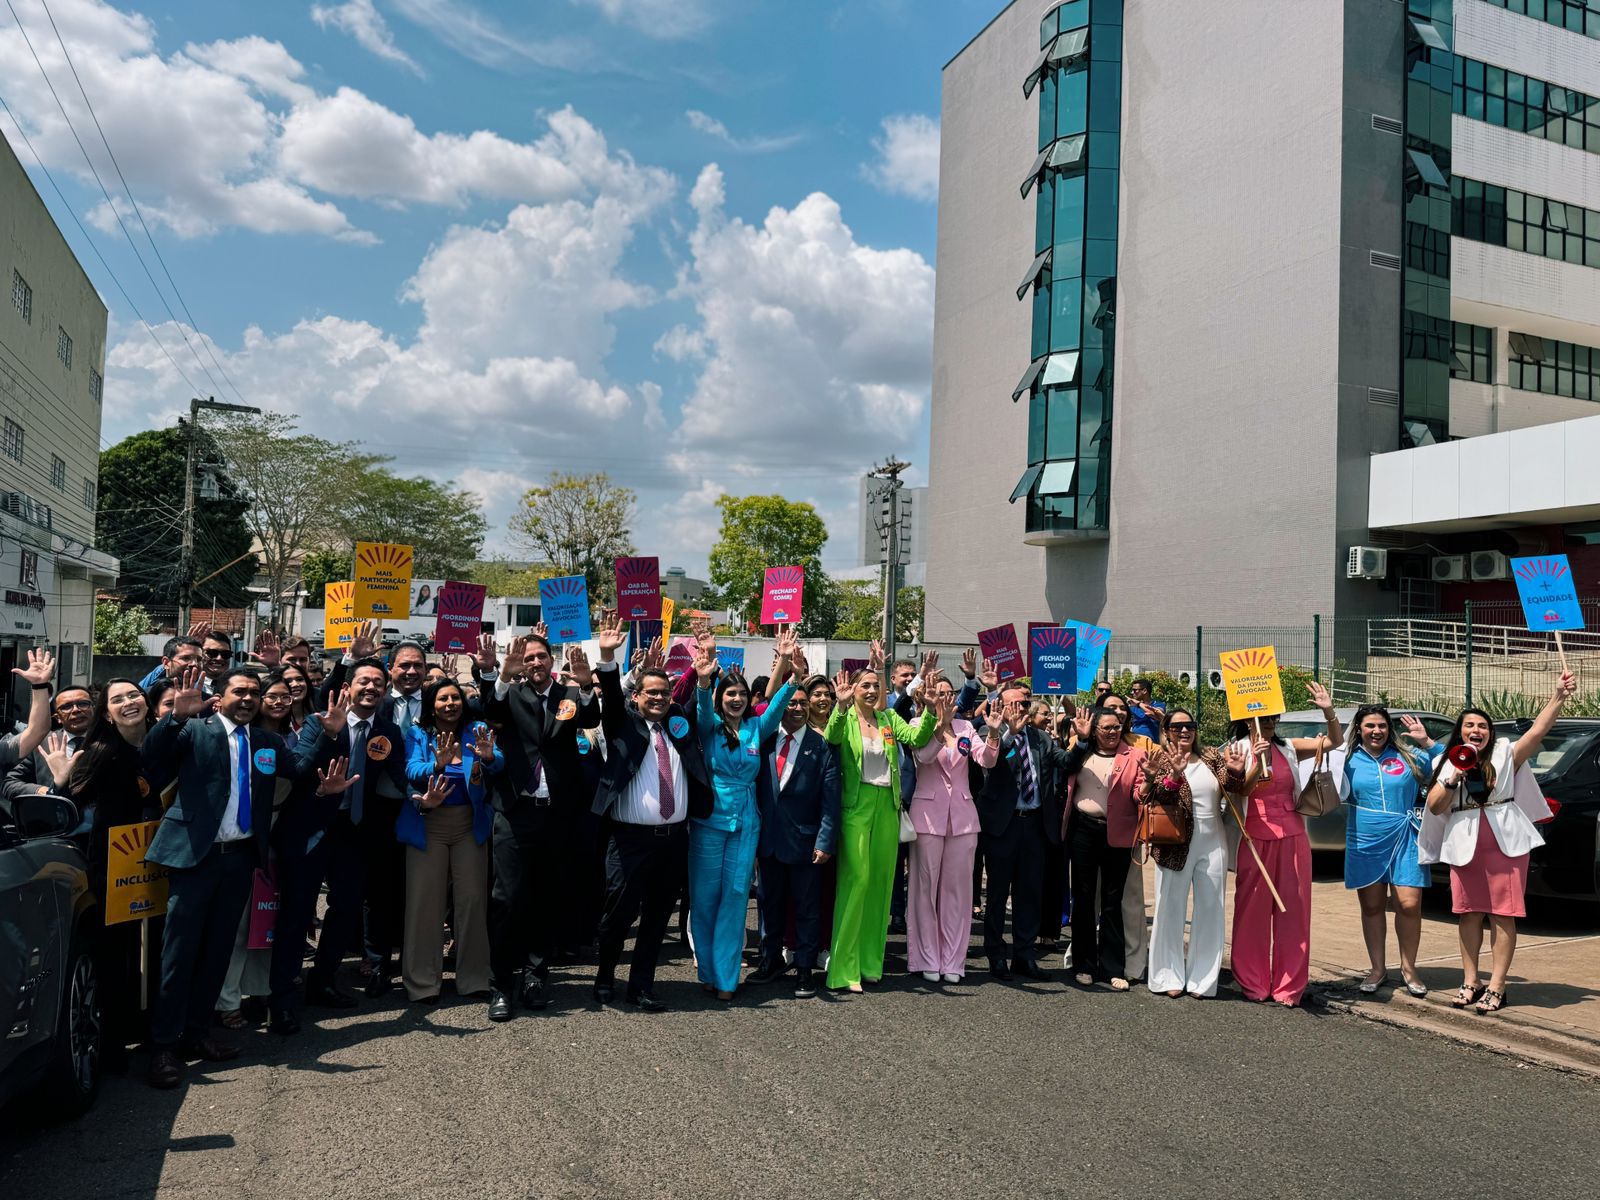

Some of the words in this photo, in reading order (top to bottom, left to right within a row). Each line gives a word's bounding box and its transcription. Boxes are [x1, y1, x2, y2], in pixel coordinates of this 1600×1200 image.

[1527, 594, 1573, 604] EQUIDADE
[1231, 674, 1272, 684] VALORIZAÇÃO
[1236, 686, 1272, 695] ADVOCACIA
